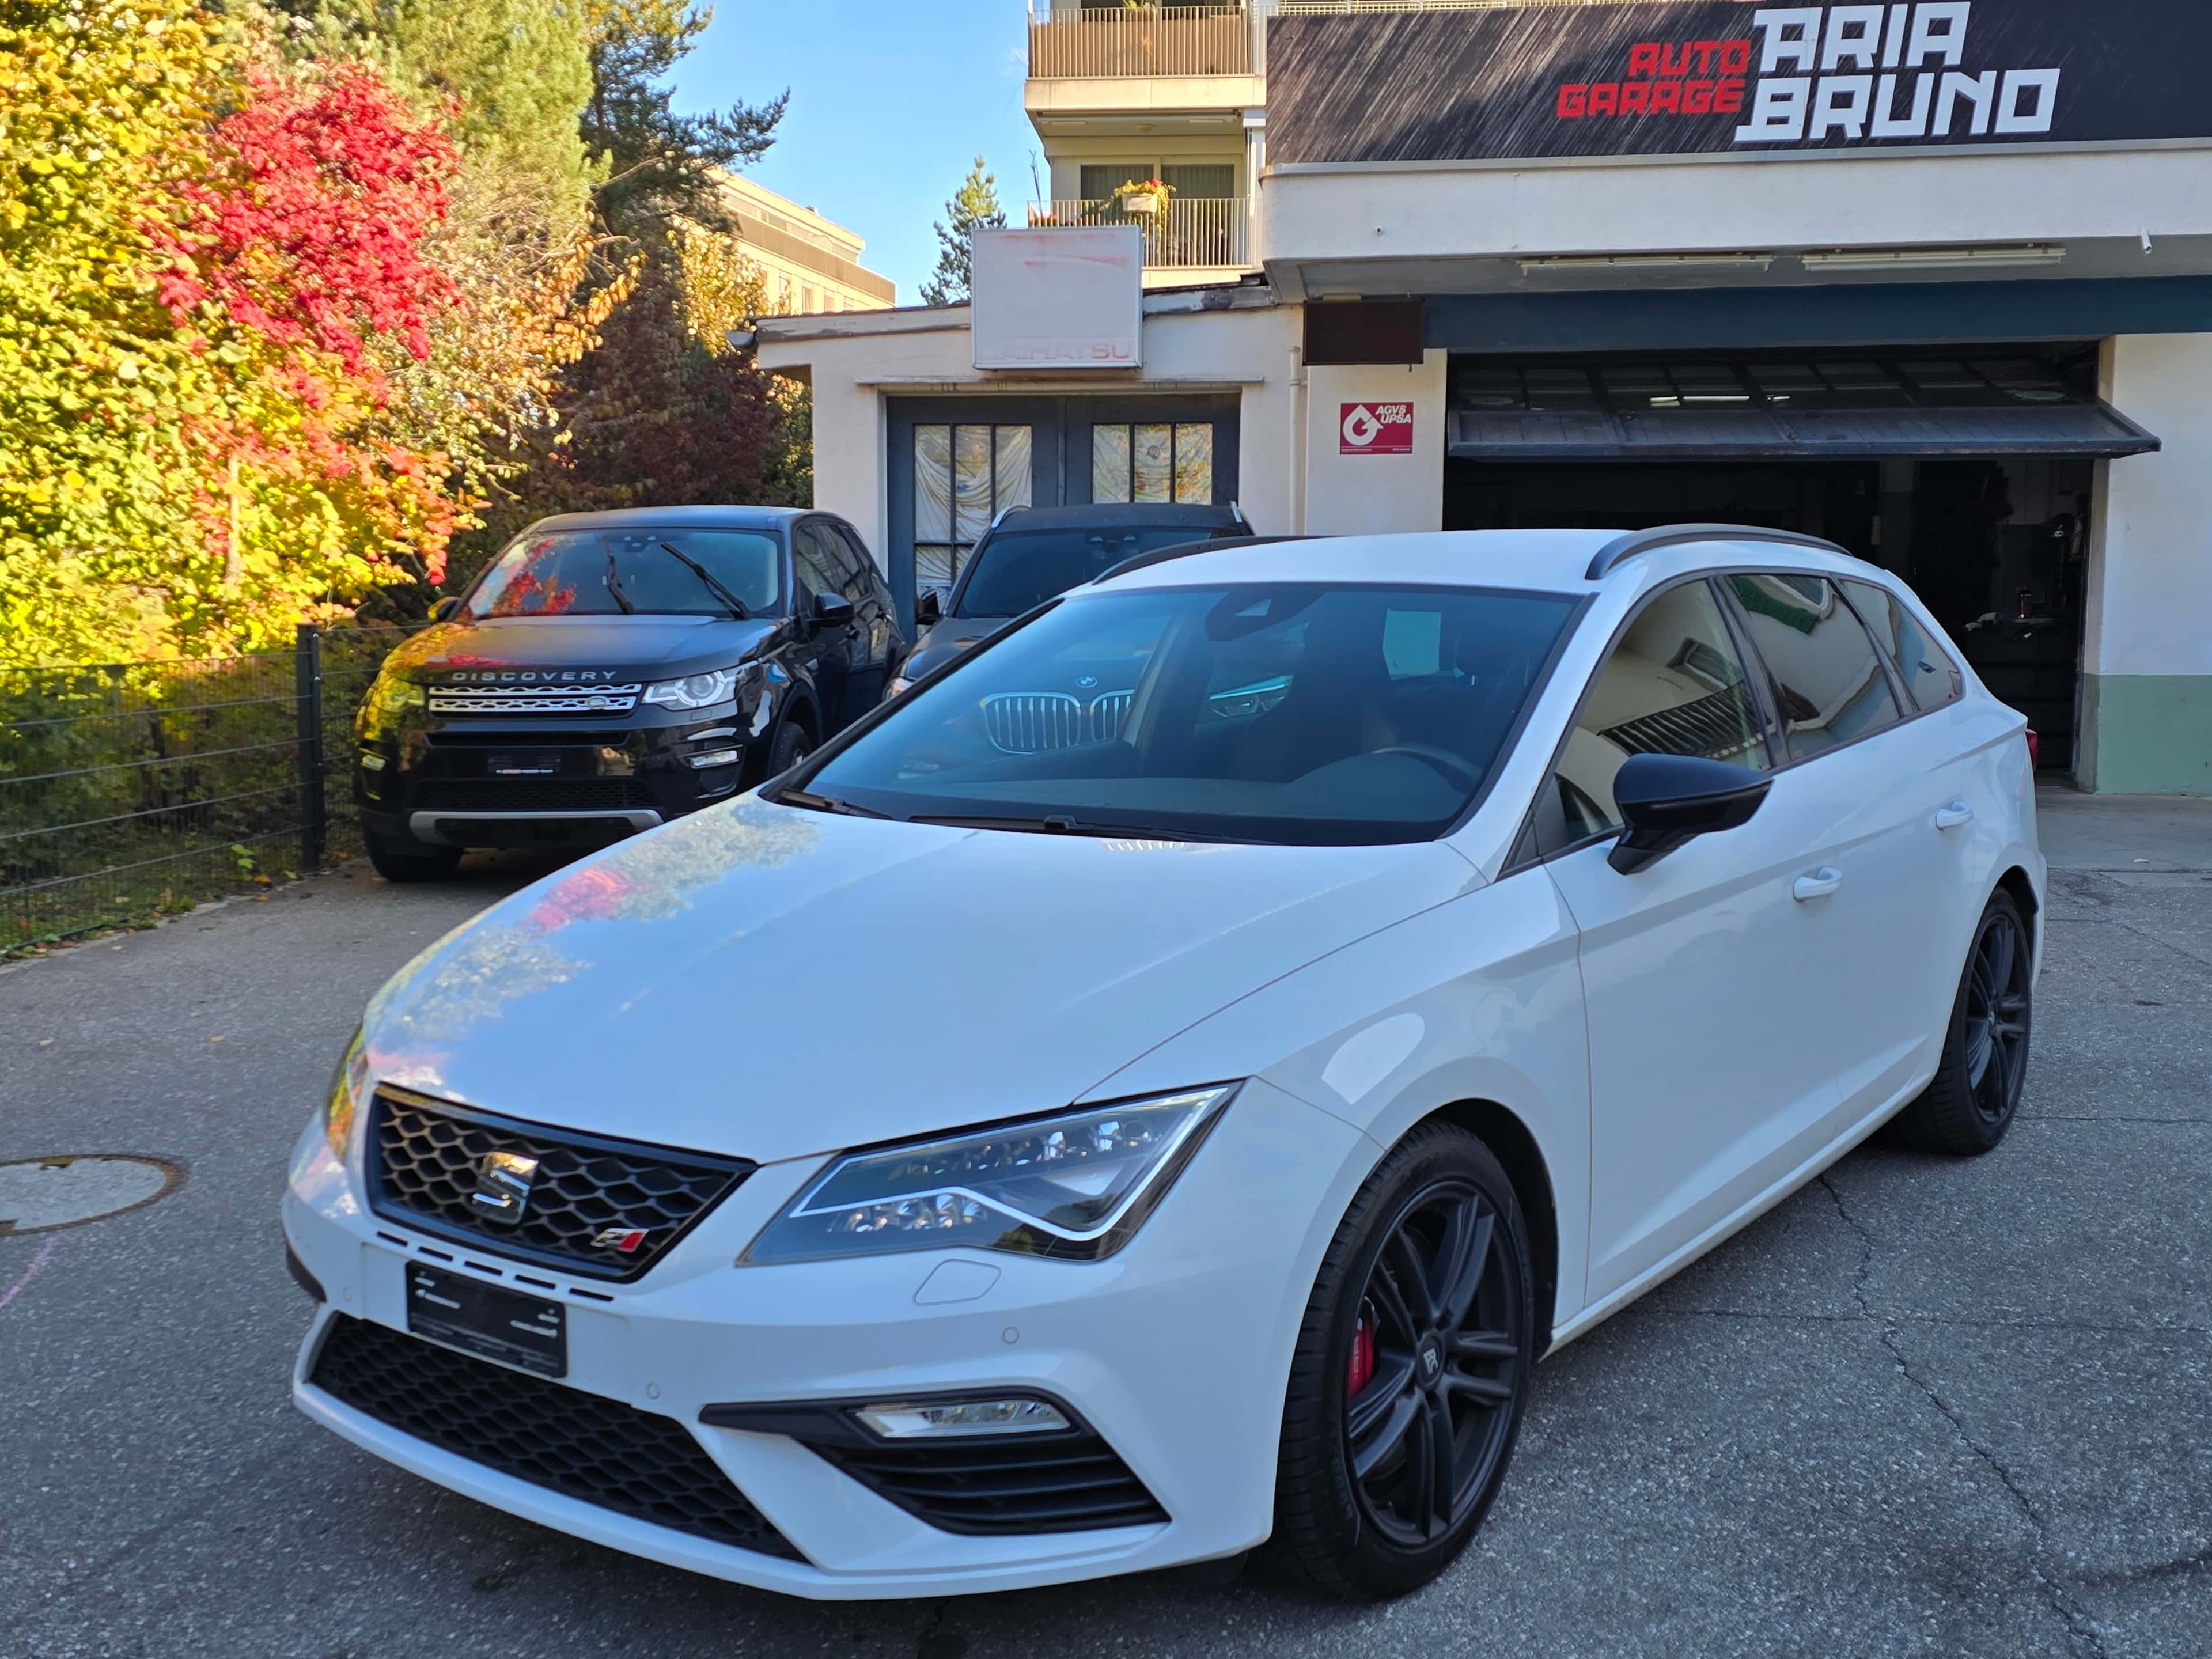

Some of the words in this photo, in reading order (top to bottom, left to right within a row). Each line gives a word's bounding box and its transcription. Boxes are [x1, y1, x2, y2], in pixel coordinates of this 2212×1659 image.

[1753, 2, 1971, 73] ARIA
[1627, 39, 1752, 77] AUTO
[1556, 78, 1745, 119] GARAGE
[1733, 67, 2061, 143] BRUNO
[1376, 404, 1407, 415] AGVS
[1380, 414, 1411, 423] UPSA
[452, 671, 616, 681] DISCOVERY
